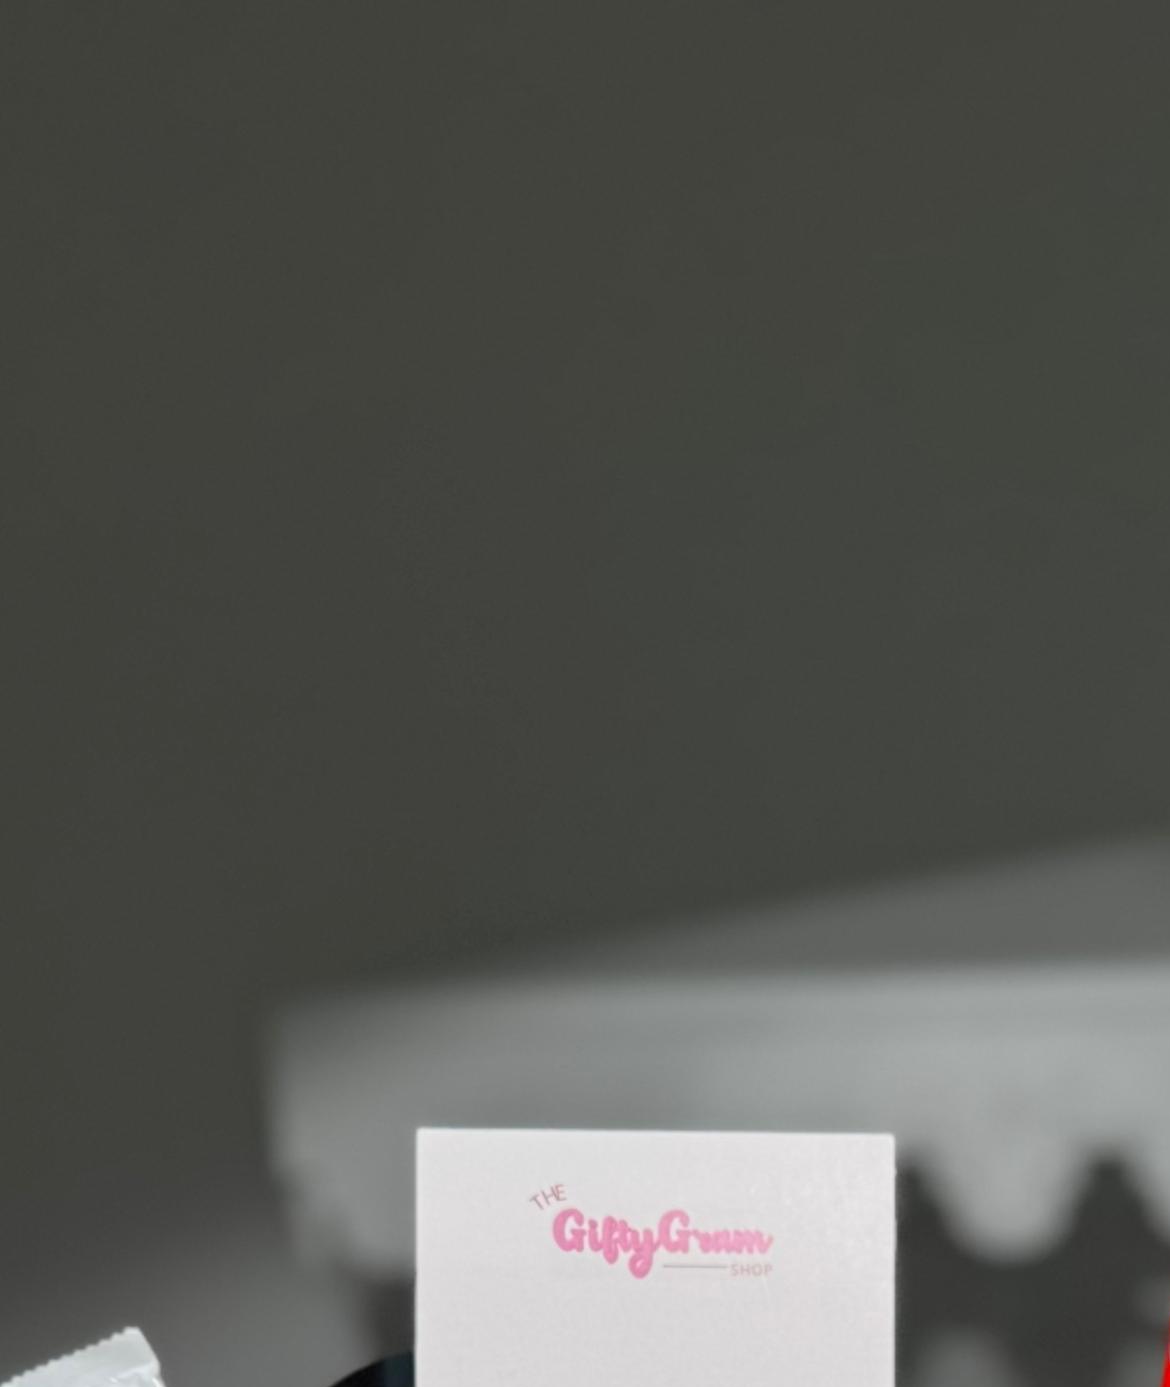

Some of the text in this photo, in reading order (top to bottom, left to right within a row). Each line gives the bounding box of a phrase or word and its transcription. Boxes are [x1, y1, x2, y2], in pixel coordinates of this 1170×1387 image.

[530, 1184, 567, 1210] THE
[552, 1208, 774, 1279] GiftyGram
[730, 1264, 773, 1277] SHOP
